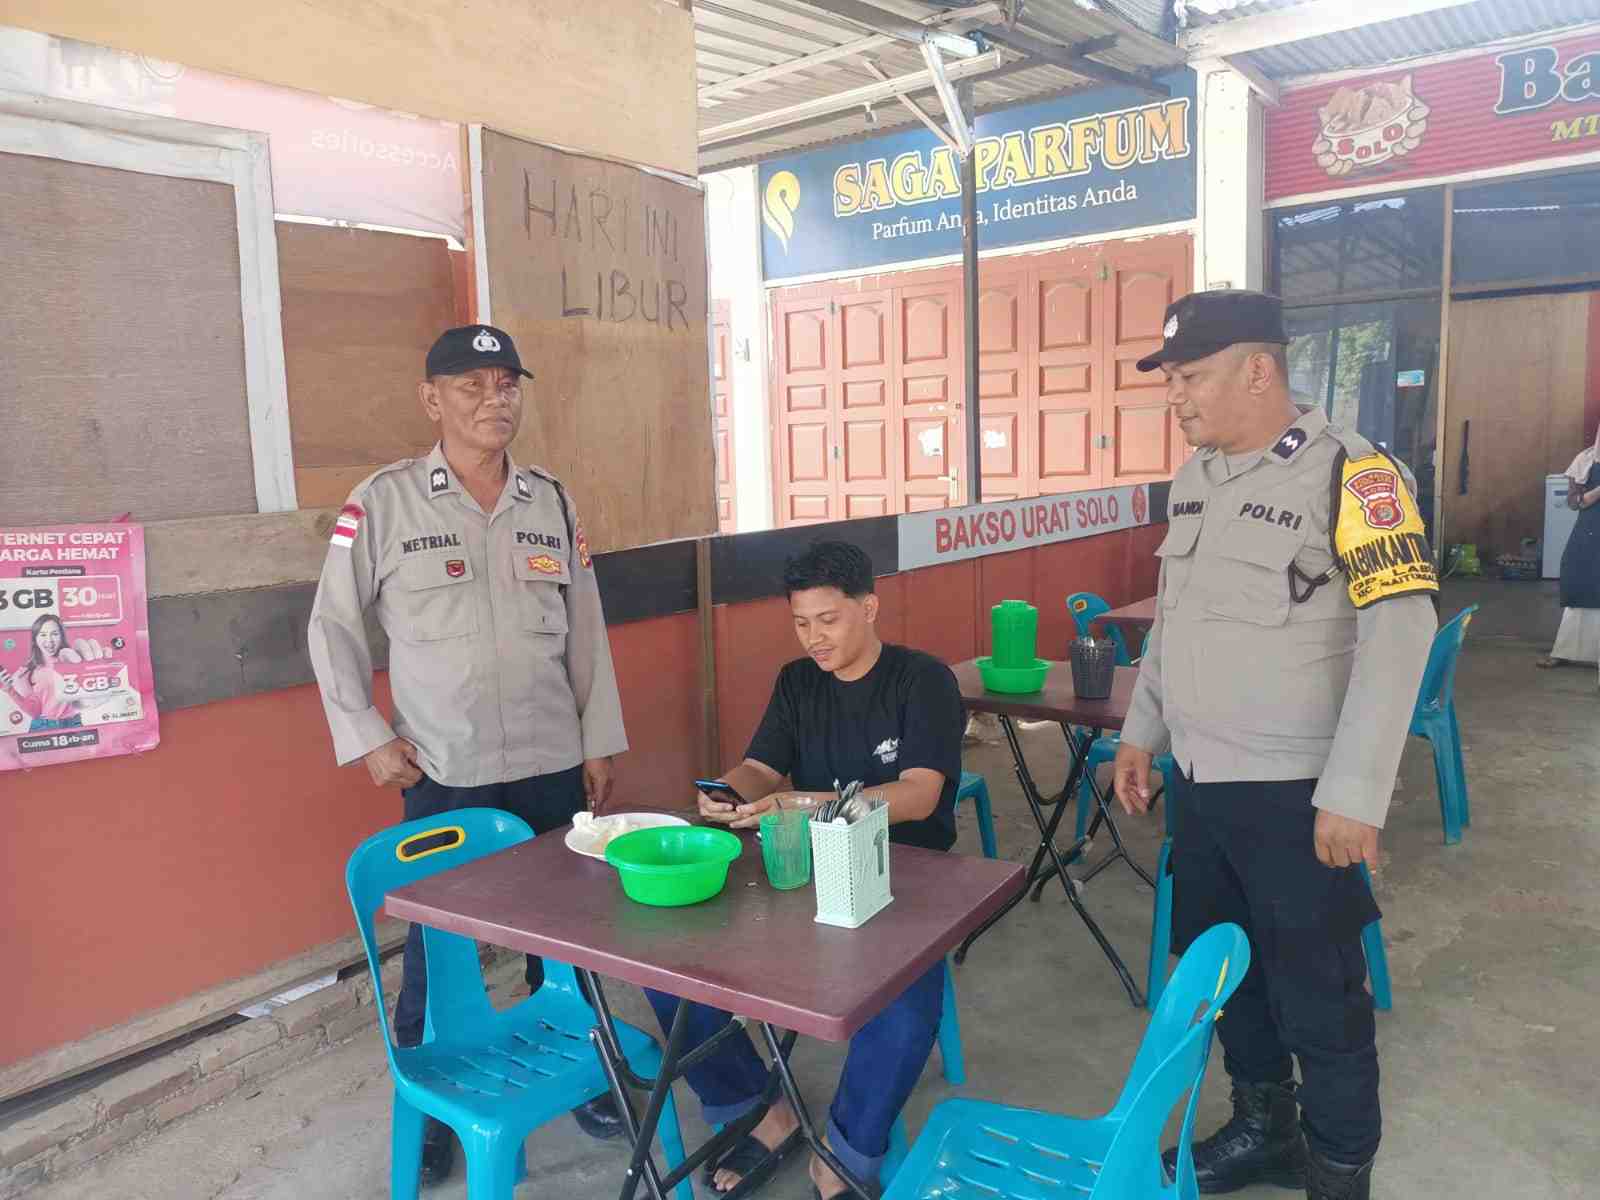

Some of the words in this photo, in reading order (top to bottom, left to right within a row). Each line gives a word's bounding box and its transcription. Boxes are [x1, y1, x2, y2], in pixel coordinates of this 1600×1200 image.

[1337, 123, 1404, 159] SOLO
[833, 145, 963, 217] SAGA
[975, 98, 1191, 192] PARFUM
[522, 167, 631, 252] HARI
[645, 203, 679, 263] INI
[872, 217, 932, 240] Parfum
[936, 209, 989, 231] Ana,
[993, 194, 1077, 221] Identitas
[1082, 180, 1138, 206] Anda
[561, 263, 690, 332] LIBUR
[935, 509, 1017, 553] BAKSO
[1022, 501, 1071, 539] URAT
[1076, 495, 1119, 529] SOLO
[1240, 502, 1303, 531] POLRI
[69, 531, 126, 545] CEPAT
[403, 533, 461, 554] METRIAL
[516, 531, 561, 550] POLRI
[57, 547, 119, 560] HEMAT
[13, 589, 53, 609] GB
[62, 586, 97, 608] 30
[82, 676, 109, 692] GB
